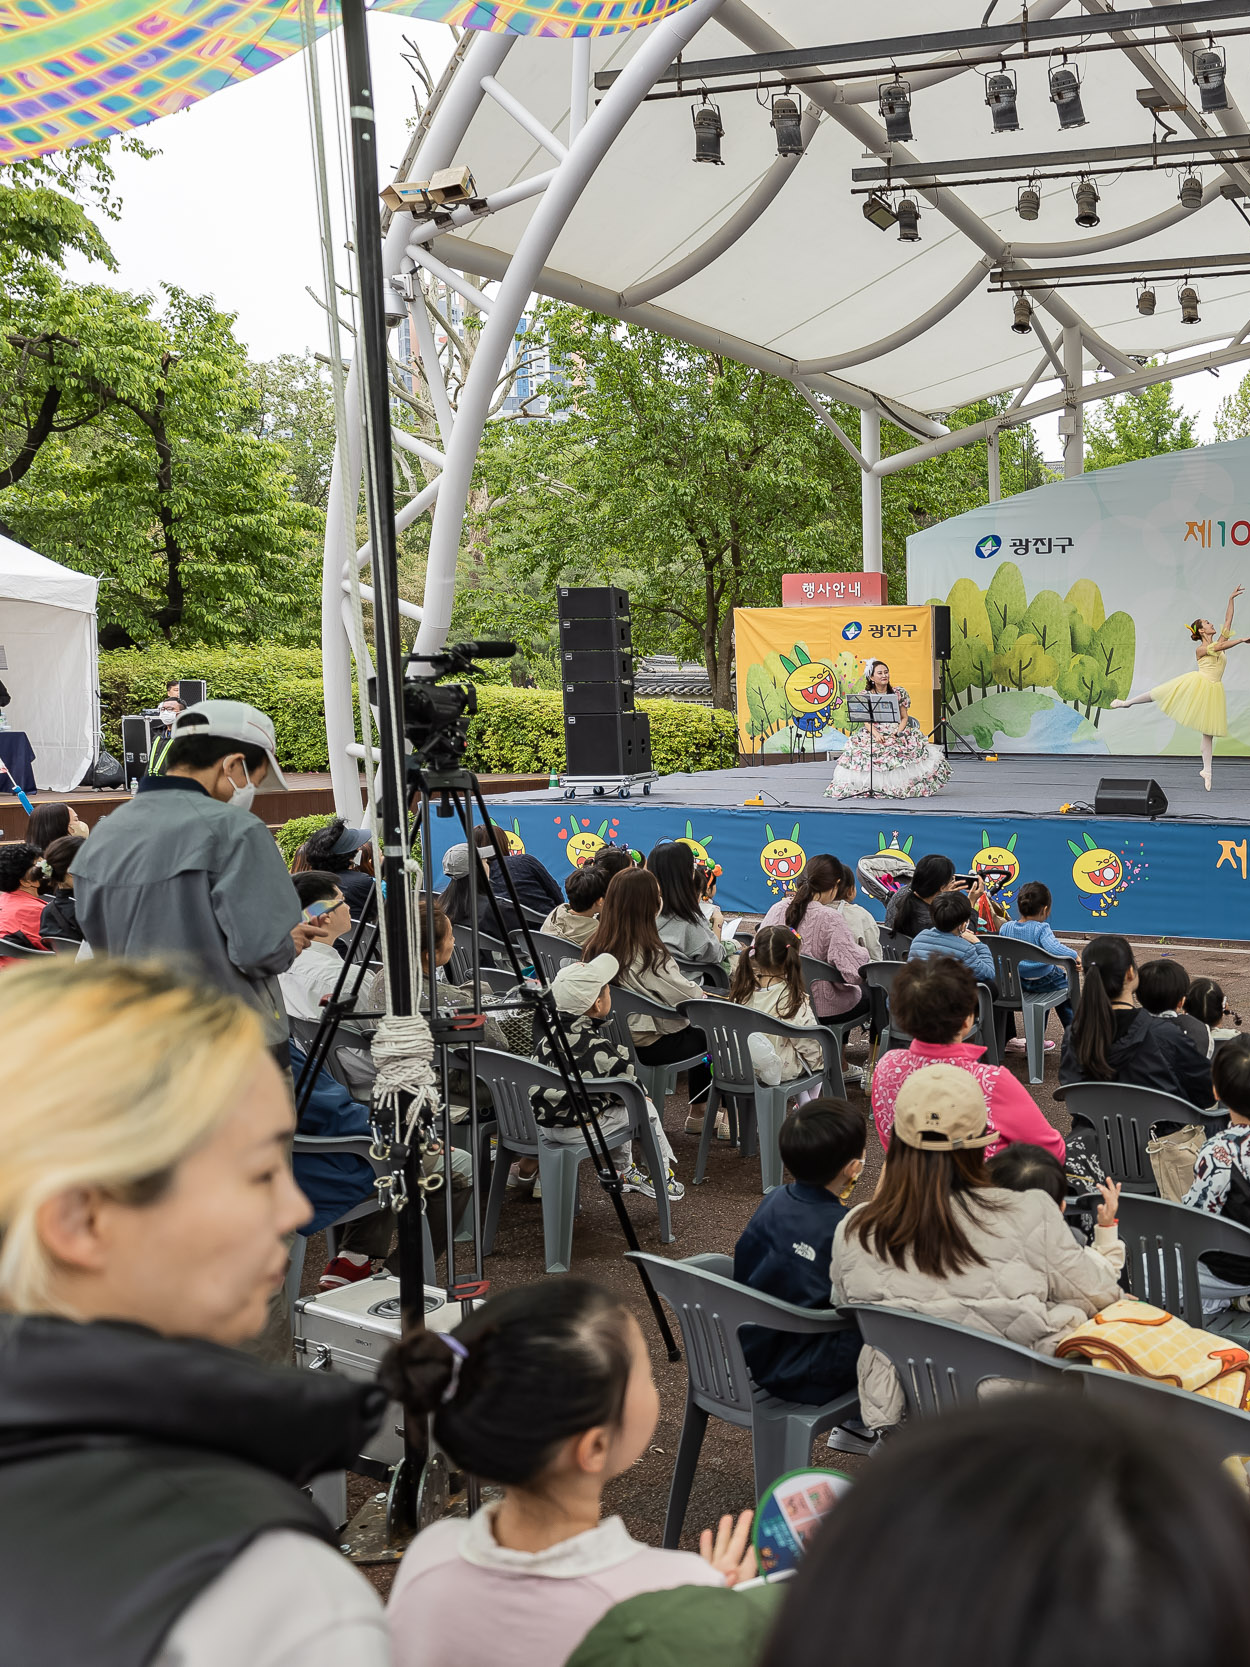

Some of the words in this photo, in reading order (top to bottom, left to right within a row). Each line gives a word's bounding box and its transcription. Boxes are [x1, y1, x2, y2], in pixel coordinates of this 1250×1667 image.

[1009, 537, 1075, 556] 광진구
[801, 581, 862, 599] 행사안내
[867, 623, 918, 639] 광진구
